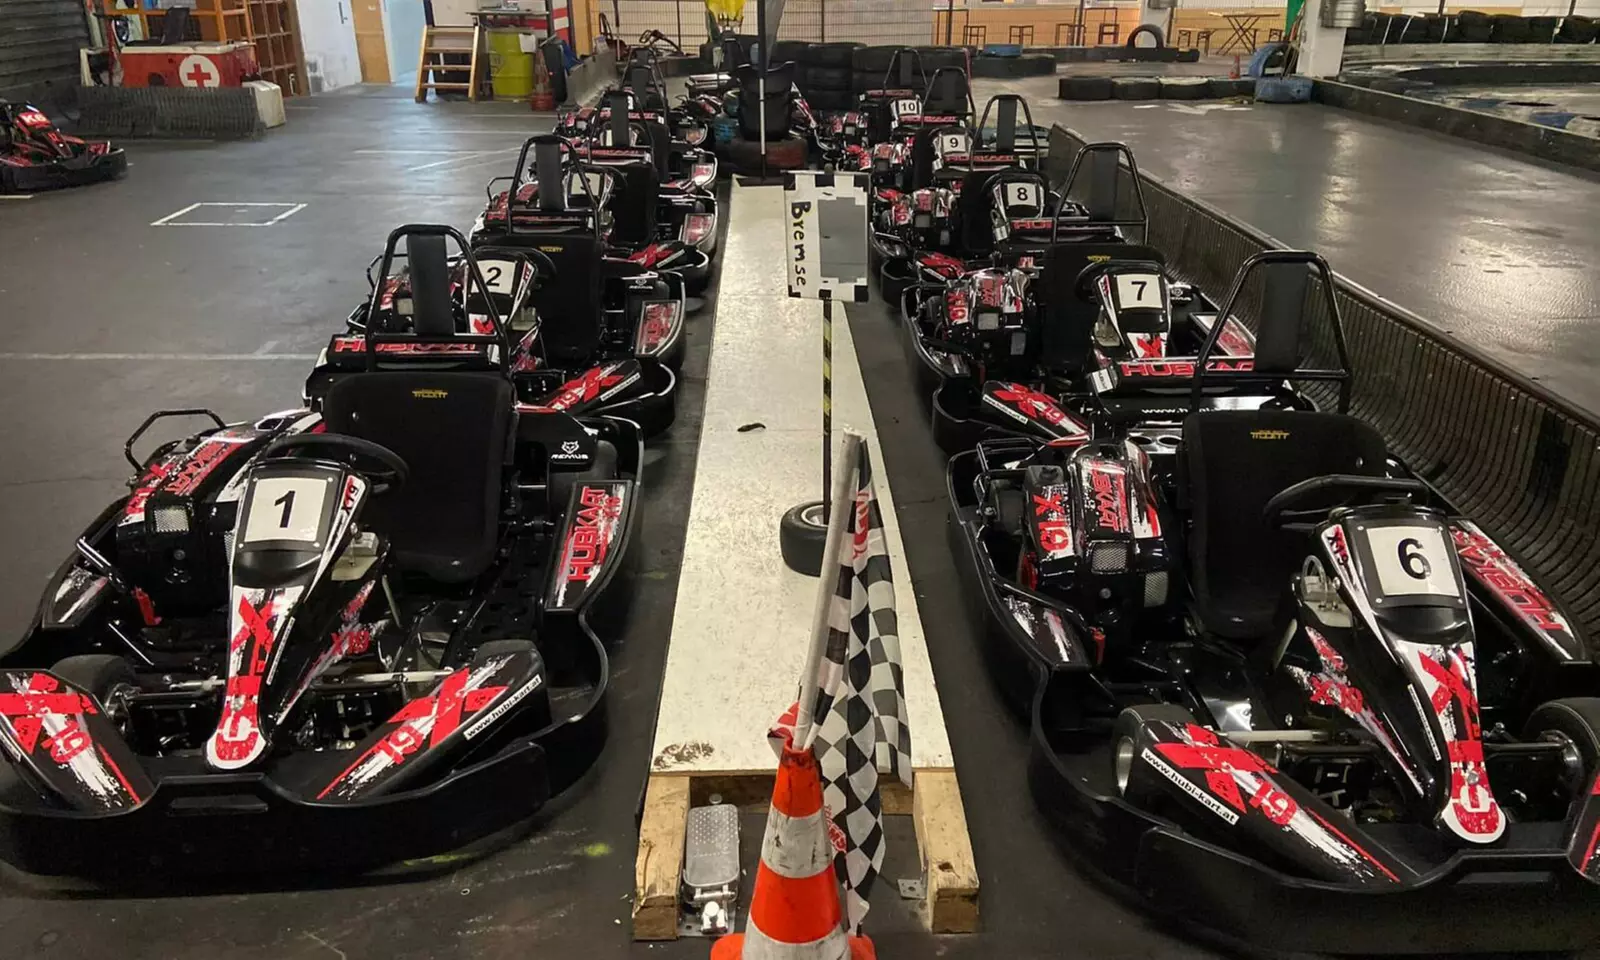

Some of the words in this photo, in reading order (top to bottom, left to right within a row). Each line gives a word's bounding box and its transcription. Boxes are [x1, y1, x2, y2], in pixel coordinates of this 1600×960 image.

[901, 103, 915, 112] 10
[950, 137, 959, 148] 9
[1017, 187, 1028, 201] 8
[792, 201, 812, 287] Bremse
[486, 266, 502, 286] 2
[1131, 281, 1147, 301] 7
[274, 490, 296, 529] 1
[1397, 537, 1432, 580] 6
[466, 675, 541, 739] www.hubi-kart.at
[1144, 751, 1237, 824] www.hubi-kart.at
